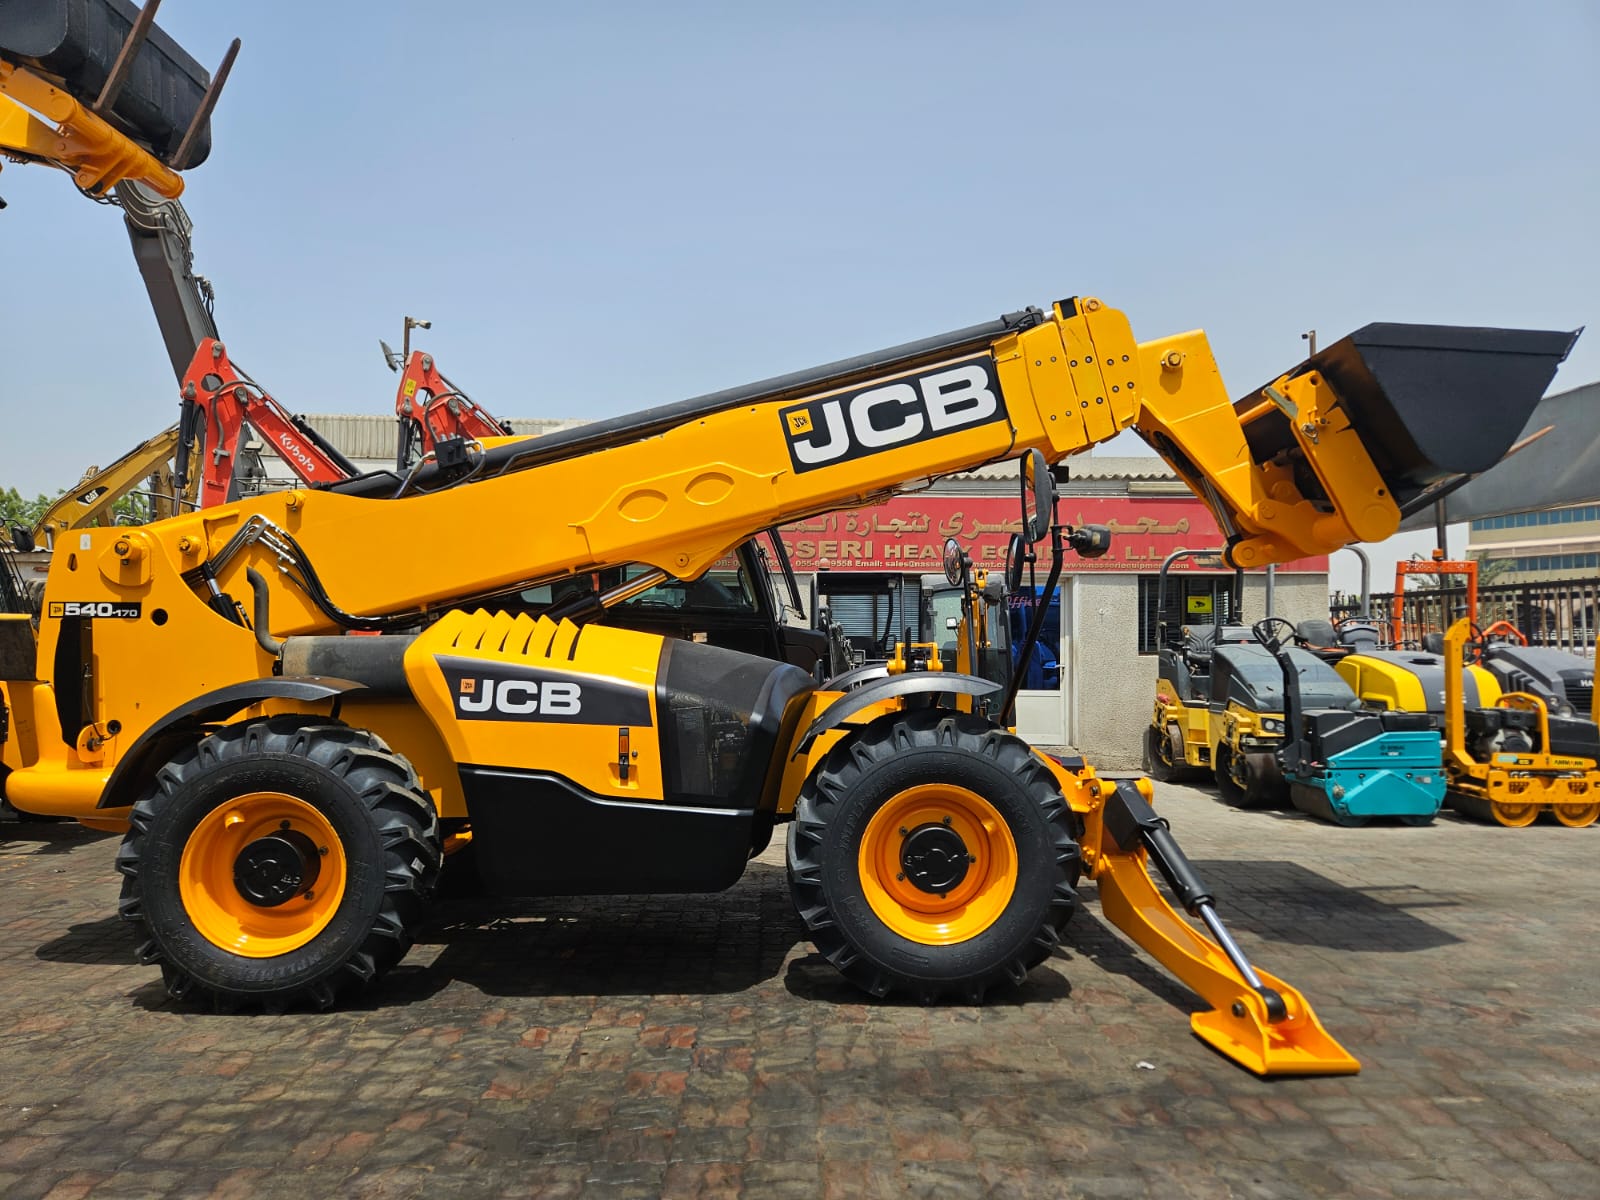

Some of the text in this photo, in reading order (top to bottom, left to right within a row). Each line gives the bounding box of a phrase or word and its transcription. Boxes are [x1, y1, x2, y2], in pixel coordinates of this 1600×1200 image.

[793, 365, 997, 464] JCB
[279, 432, 315, 473] Kubota
[854, 559, 884, 568] Email:
[64, 602, 138, 617] 540-170
[459, 679, 582, 716] JCB
